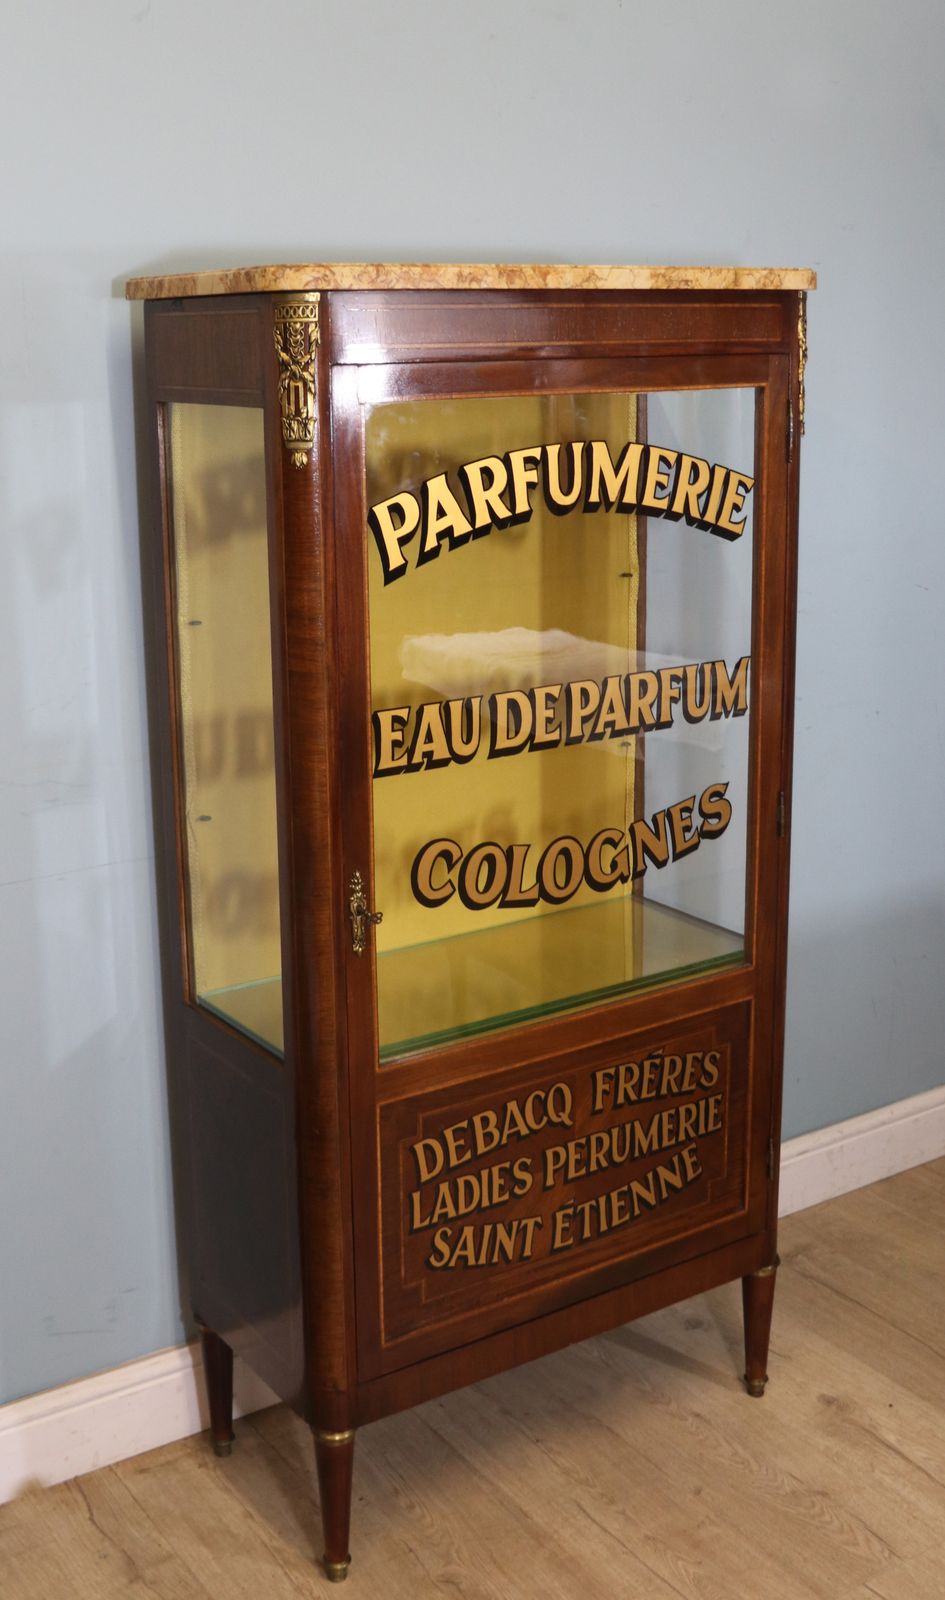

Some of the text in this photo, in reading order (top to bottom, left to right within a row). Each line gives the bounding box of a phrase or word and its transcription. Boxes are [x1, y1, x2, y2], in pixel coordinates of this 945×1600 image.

[367, 440, 755, 586] PARFUMERIE
[373, 655, 751, 778] EAU DE PARFUM
[410, 781, 733, 910] COLOGNES
[409, 1093, 723, 1234] LADIES PERUMERIE
[412, 1049, 721, 1185] DEBACQ FRÉRES
[427, 1143, 703, 1270] SAINT ÉTIENNE
